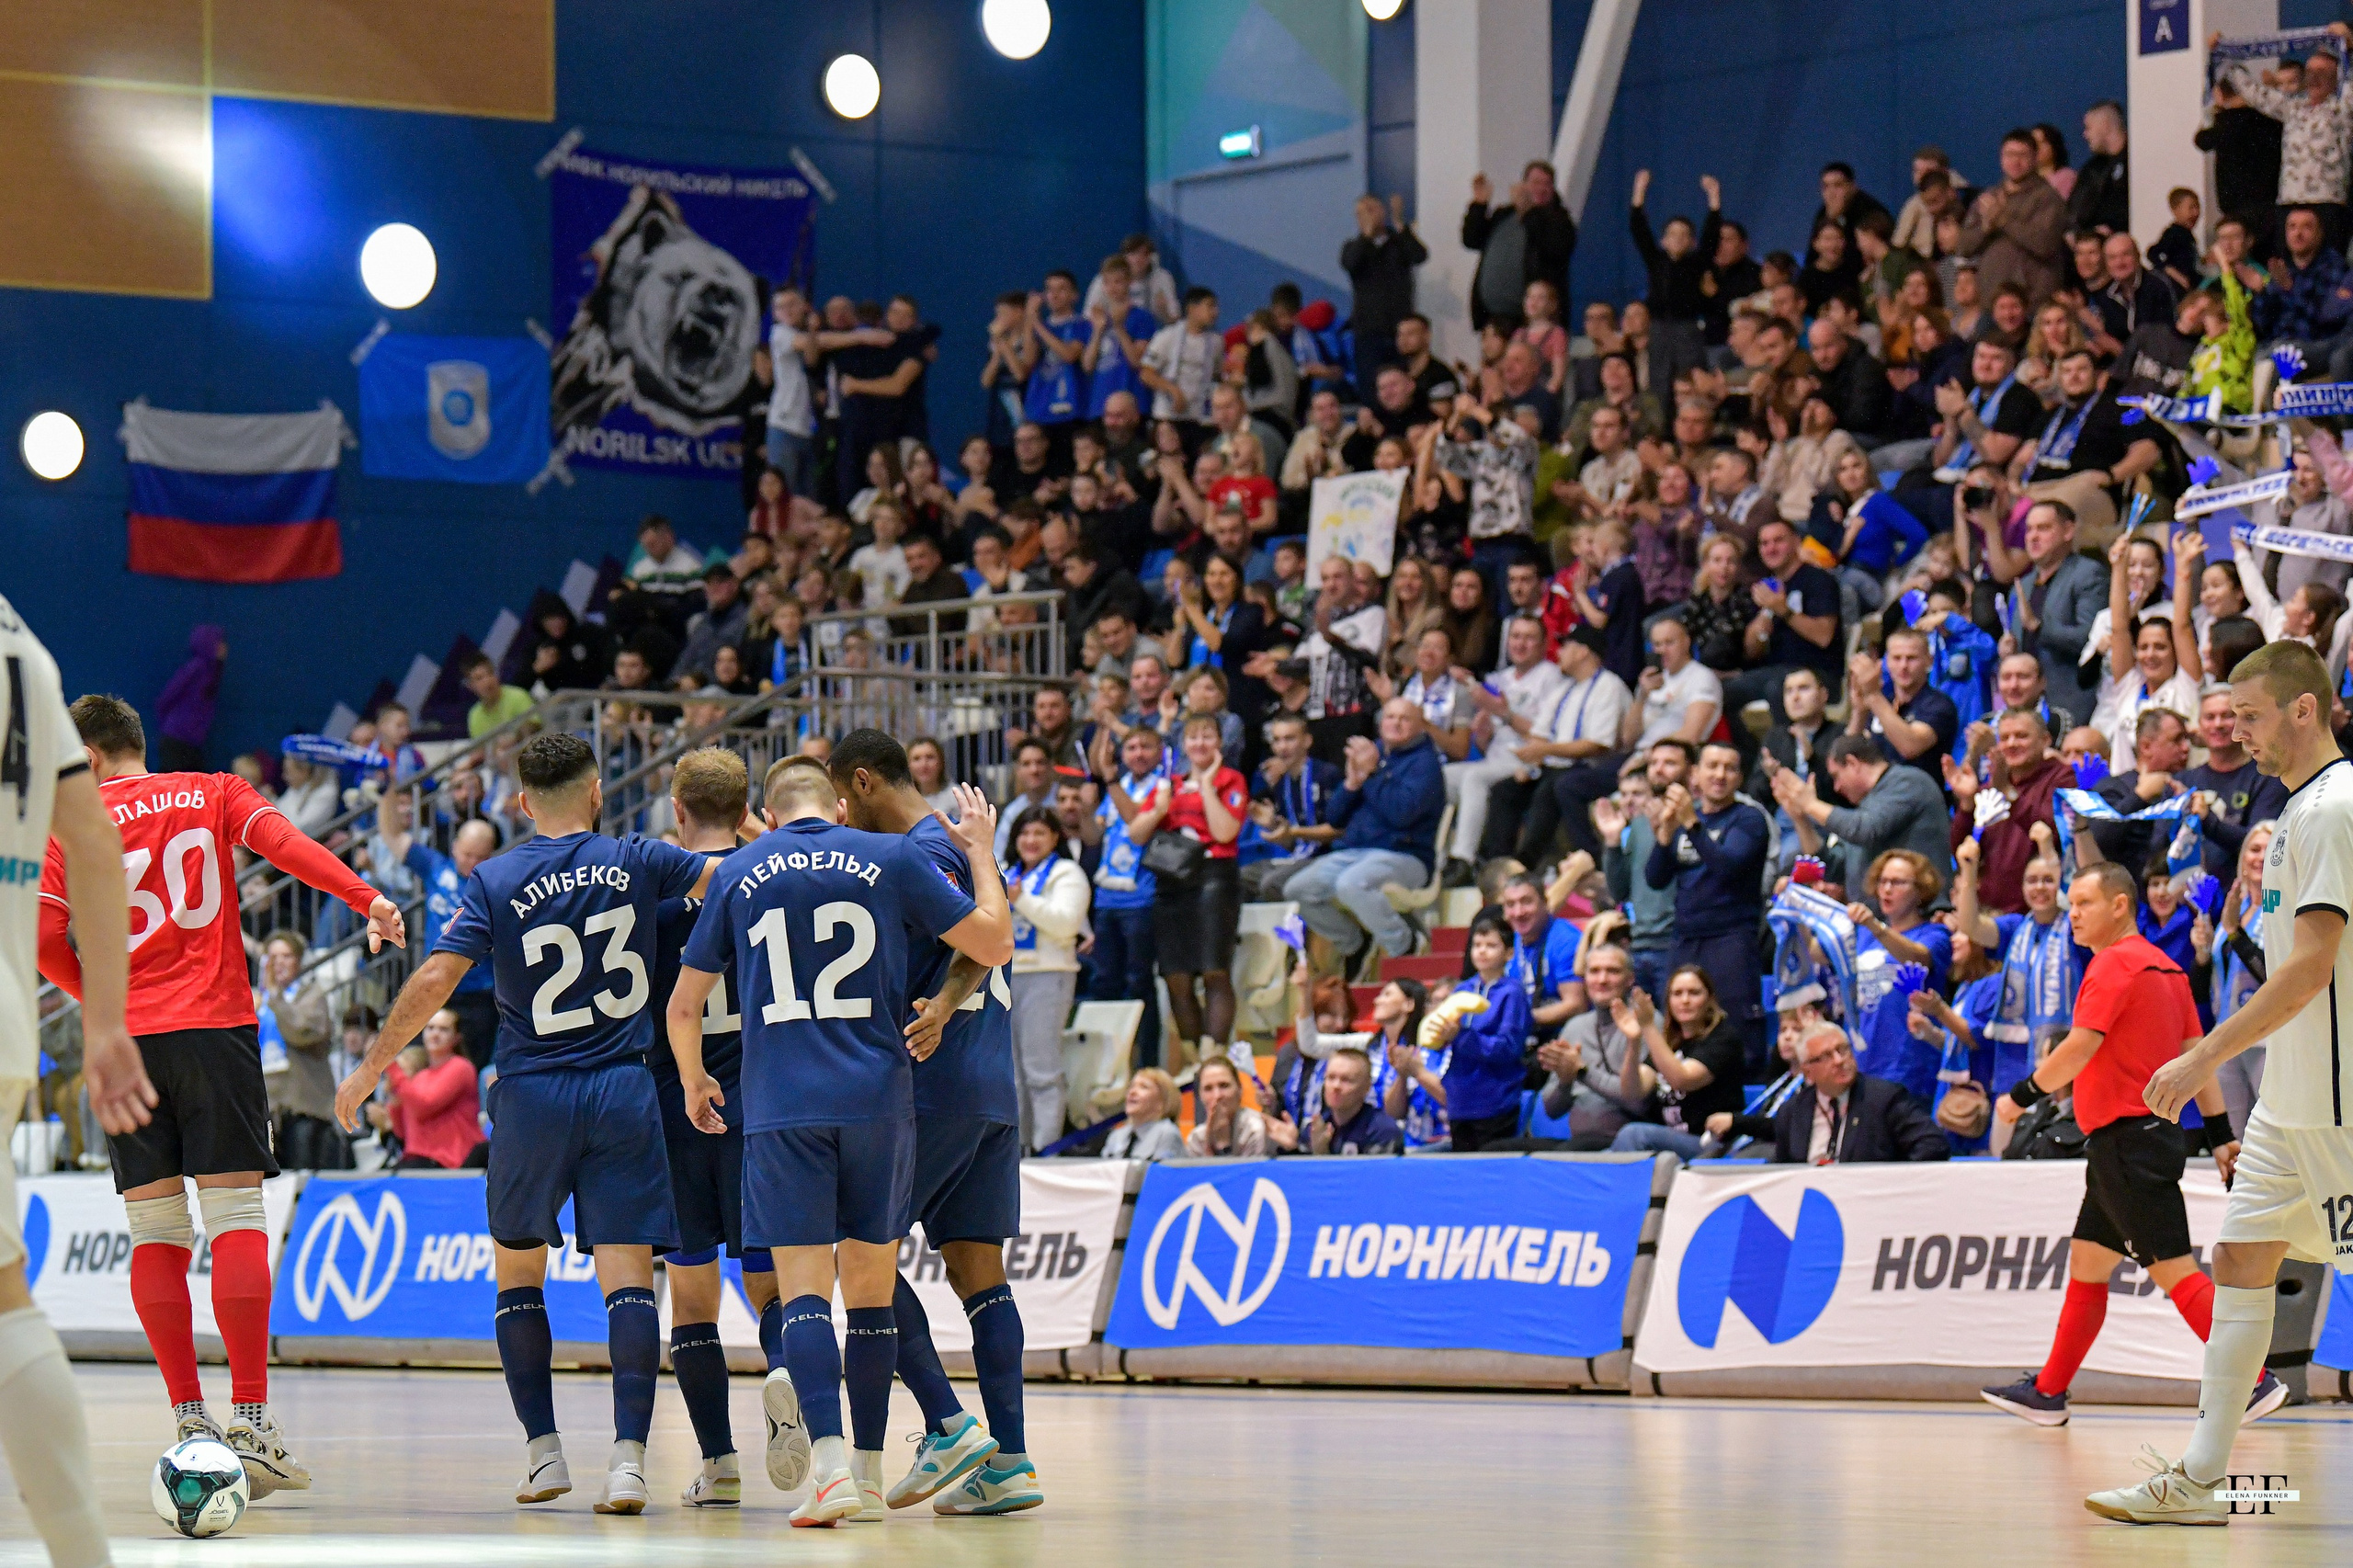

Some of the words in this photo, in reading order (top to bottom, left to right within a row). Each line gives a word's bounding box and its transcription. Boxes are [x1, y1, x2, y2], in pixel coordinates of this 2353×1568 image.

[111, 790, 206, 826] ЛАШОВ
[510, 865, 631, 920] АЛИБЕКОВ
[739, 850, 882, 899] ЛЕЙФЕЛЬД
[521, 903, 650, 1036] 23
[747, 901, 876, 1026] 12
[2322, 1194, 2353, 1244] 12
[1309, 1222, 1611, 1288] НОРНИКЕЛЬ
